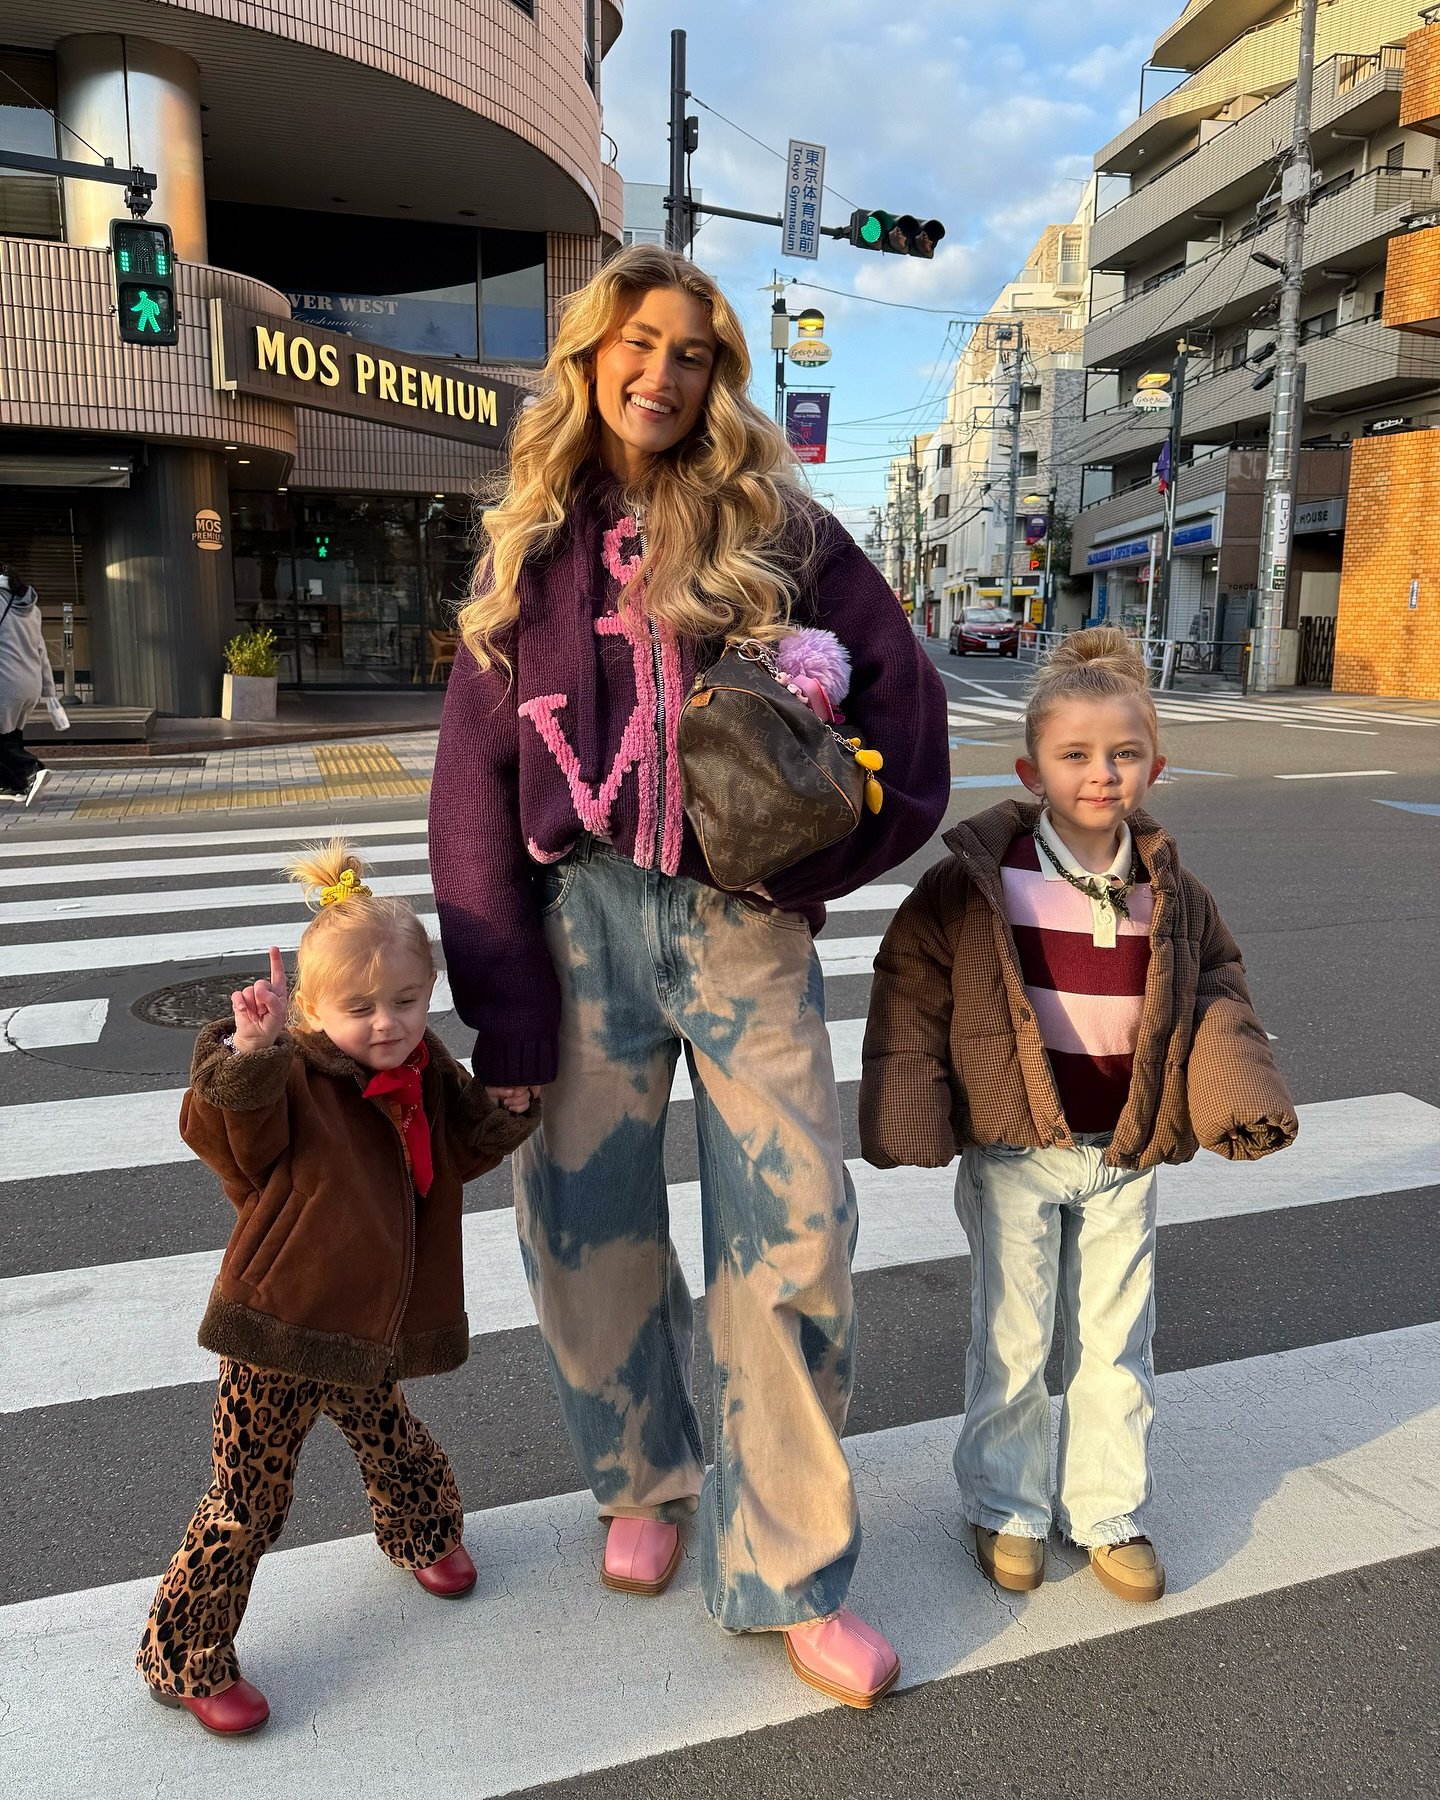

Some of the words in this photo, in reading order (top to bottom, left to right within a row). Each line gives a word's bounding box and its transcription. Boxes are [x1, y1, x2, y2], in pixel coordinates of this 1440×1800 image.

[791, 147, 803, 181] Tokyo
[799, 149, 820, 254] 東京体育館前
[787, 185, 800, 251] Gymnasium
[284, 293, 334, 311] VER
[339, 297, 399, 316] WEST
[255, 325, 340, 387] MOS
[355, 352, 498, 427] PREMIUM
[196, 519, 222, 533] MOS
[1300, 510, 1329, 525] HOUSE
[1030, 560, 1040, 570] P
